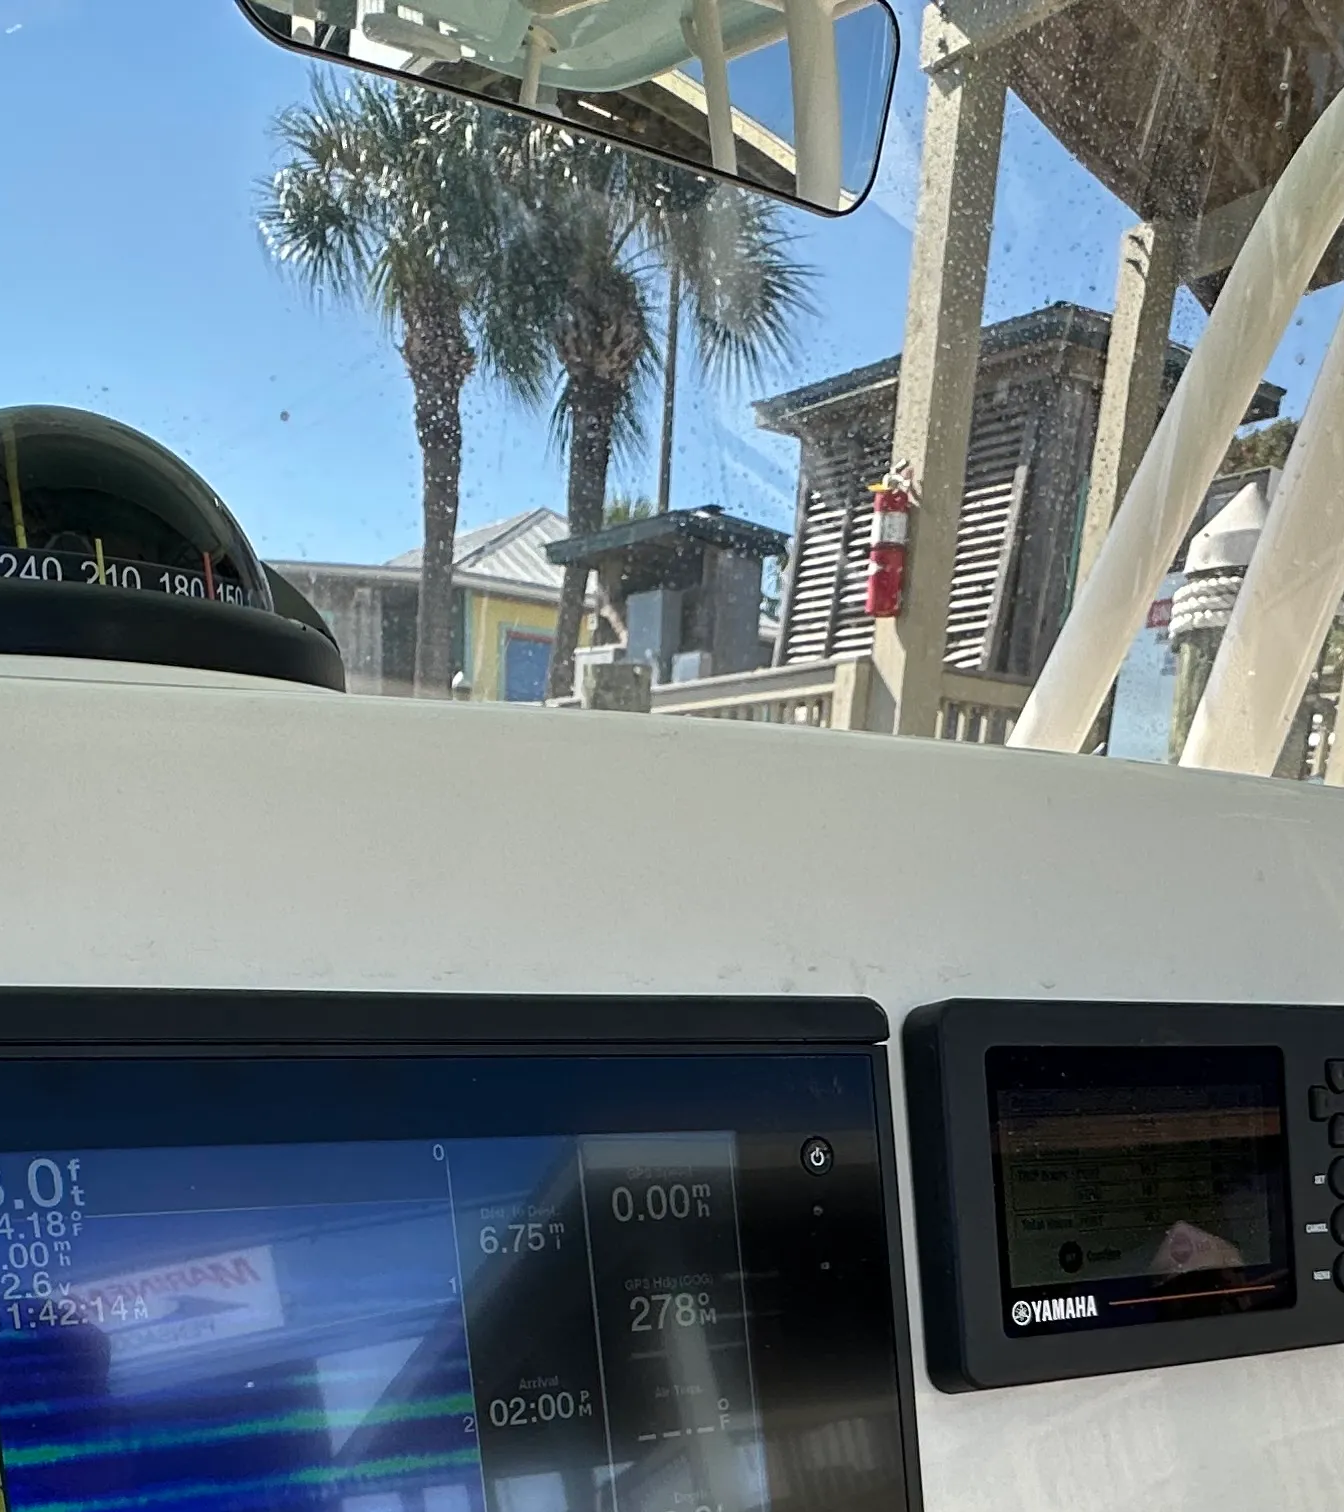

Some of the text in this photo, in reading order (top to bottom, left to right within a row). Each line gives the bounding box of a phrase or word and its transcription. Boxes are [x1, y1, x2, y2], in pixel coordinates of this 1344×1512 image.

[0, 552, 62, 581] 240
[81, 560, 141, 590] 210
[160, 571, 203, 598] 180
[217, 582, 243, 607] 150
[611, 1184, 691, 1222] 0.00
[479, 1222, 546, 1255] 6.75
[629, 1293, 697, 1333] 278
[1030, 1294, 1099, 1323] YAMAHA
[489, 1391, 575, 1428] 02:00
